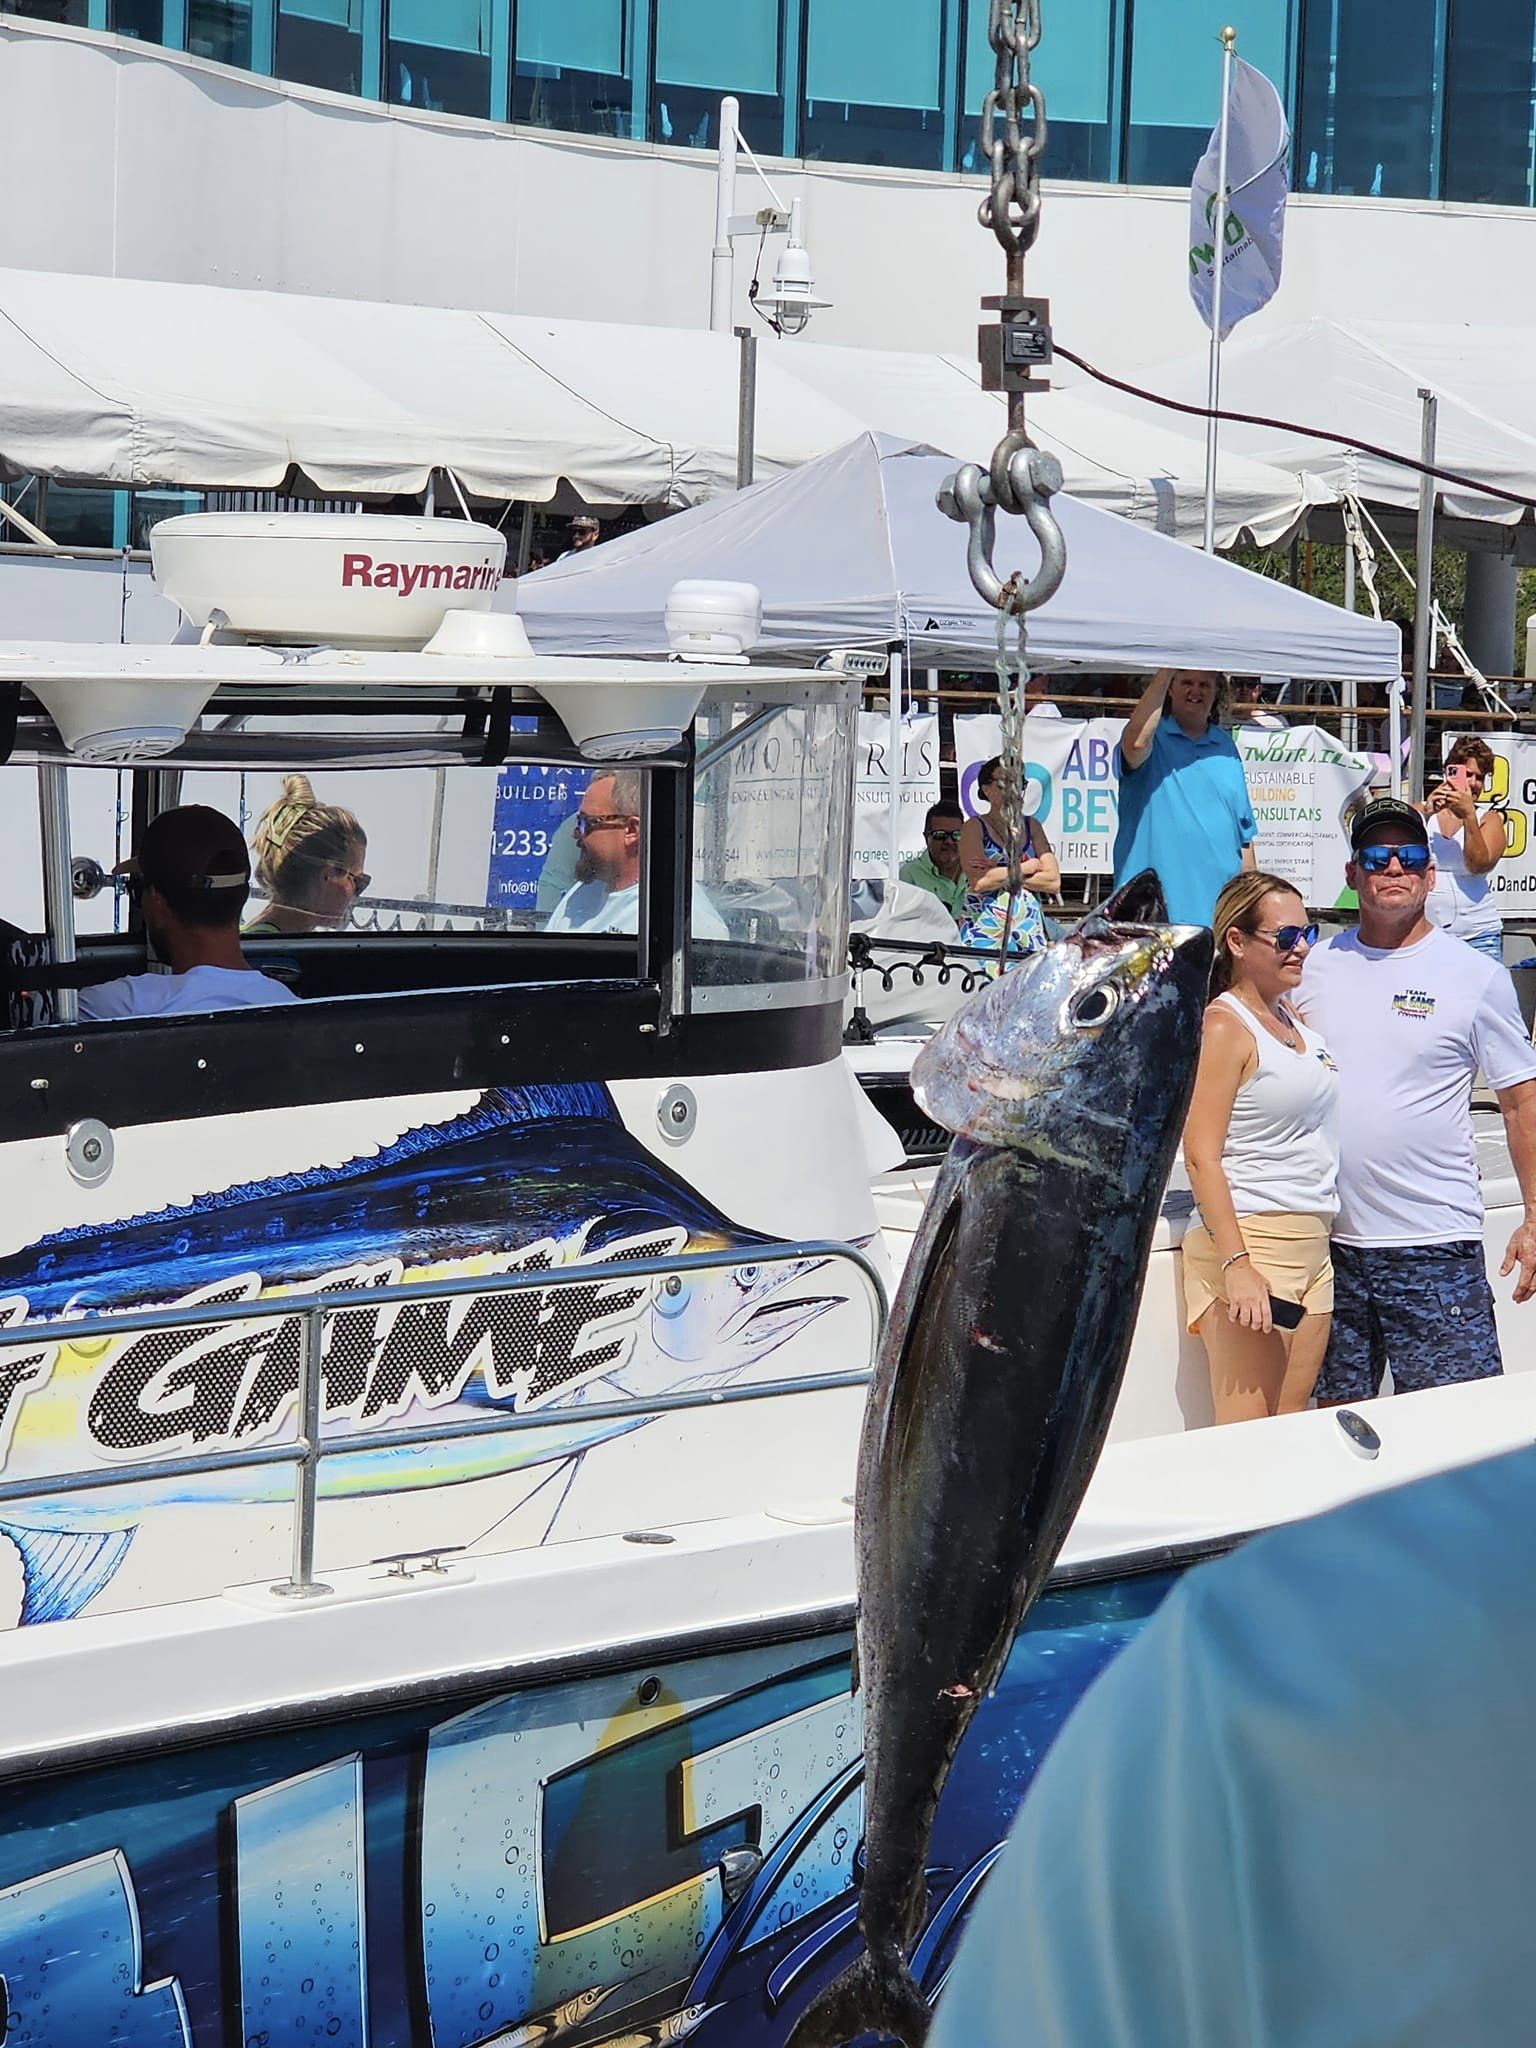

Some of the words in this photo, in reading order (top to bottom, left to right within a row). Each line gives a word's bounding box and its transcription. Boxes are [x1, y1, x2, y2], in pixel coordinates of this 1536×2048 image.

[1244, 772, 1315, 785] SUSTAINABLE
[1250, 787, 1296, 801] UILDING
[1067, 843, 1099, 858] FIRE
